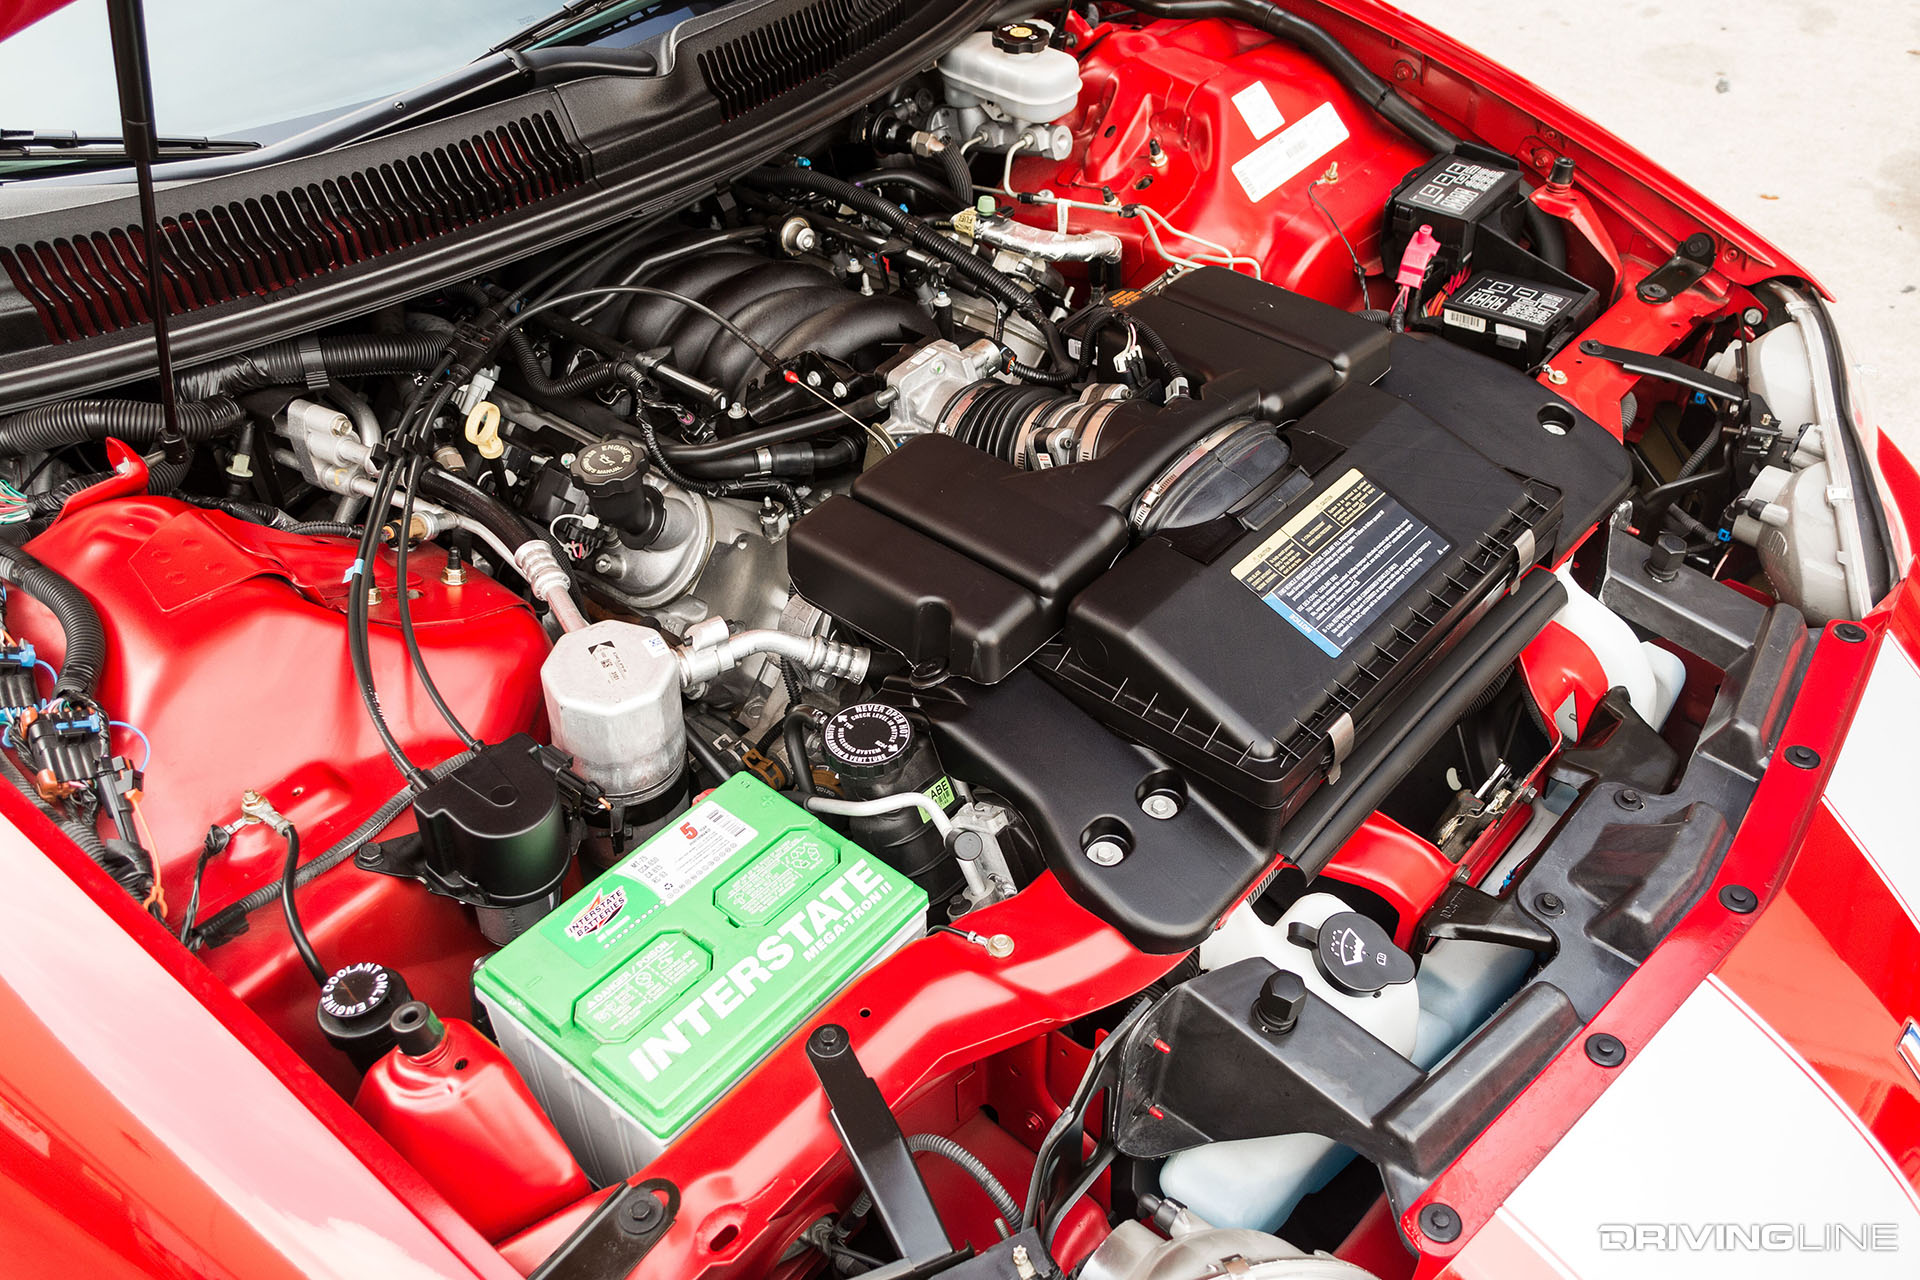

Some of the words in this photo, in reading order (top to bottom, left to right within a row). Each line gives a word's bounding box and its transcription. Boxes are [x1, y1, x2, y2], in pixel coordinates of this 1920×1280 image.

[850, 712, 871, 720] CHECK
[872, 713, 889, 722] LEVEL
[888, 726, 898, 743] BOTTLE
[854, 705, 884, 713] NEVER
[886, 707, 904, 724] OPEN
[898, 724, 908, 738] HOT
[828, 740, 845, 757] ARROW
[849, 754, 867, 763] VENT
[869, 754, 887, 762] TUBE
[839, 738, 856, 753] CLOSED
[930, 780, 949, 800] ABE
[680, 822, 698, 839] 5
[566, 889, 624, 933] INTERSTATE
[574, 896, 627, 936] BATTERIES
[802, 891, 882, 961] MEGA-TRON
[322, 962, 383, 992] COOLANT
[591, 970, 632, 1003] DANGER
[634, 940, 670, 968] POISON
[627, 858, 887, 1082] INTERSTATE
[321, 994, 366, 1015] ENGINE
[368, 973, 388, 1005] ONLY
